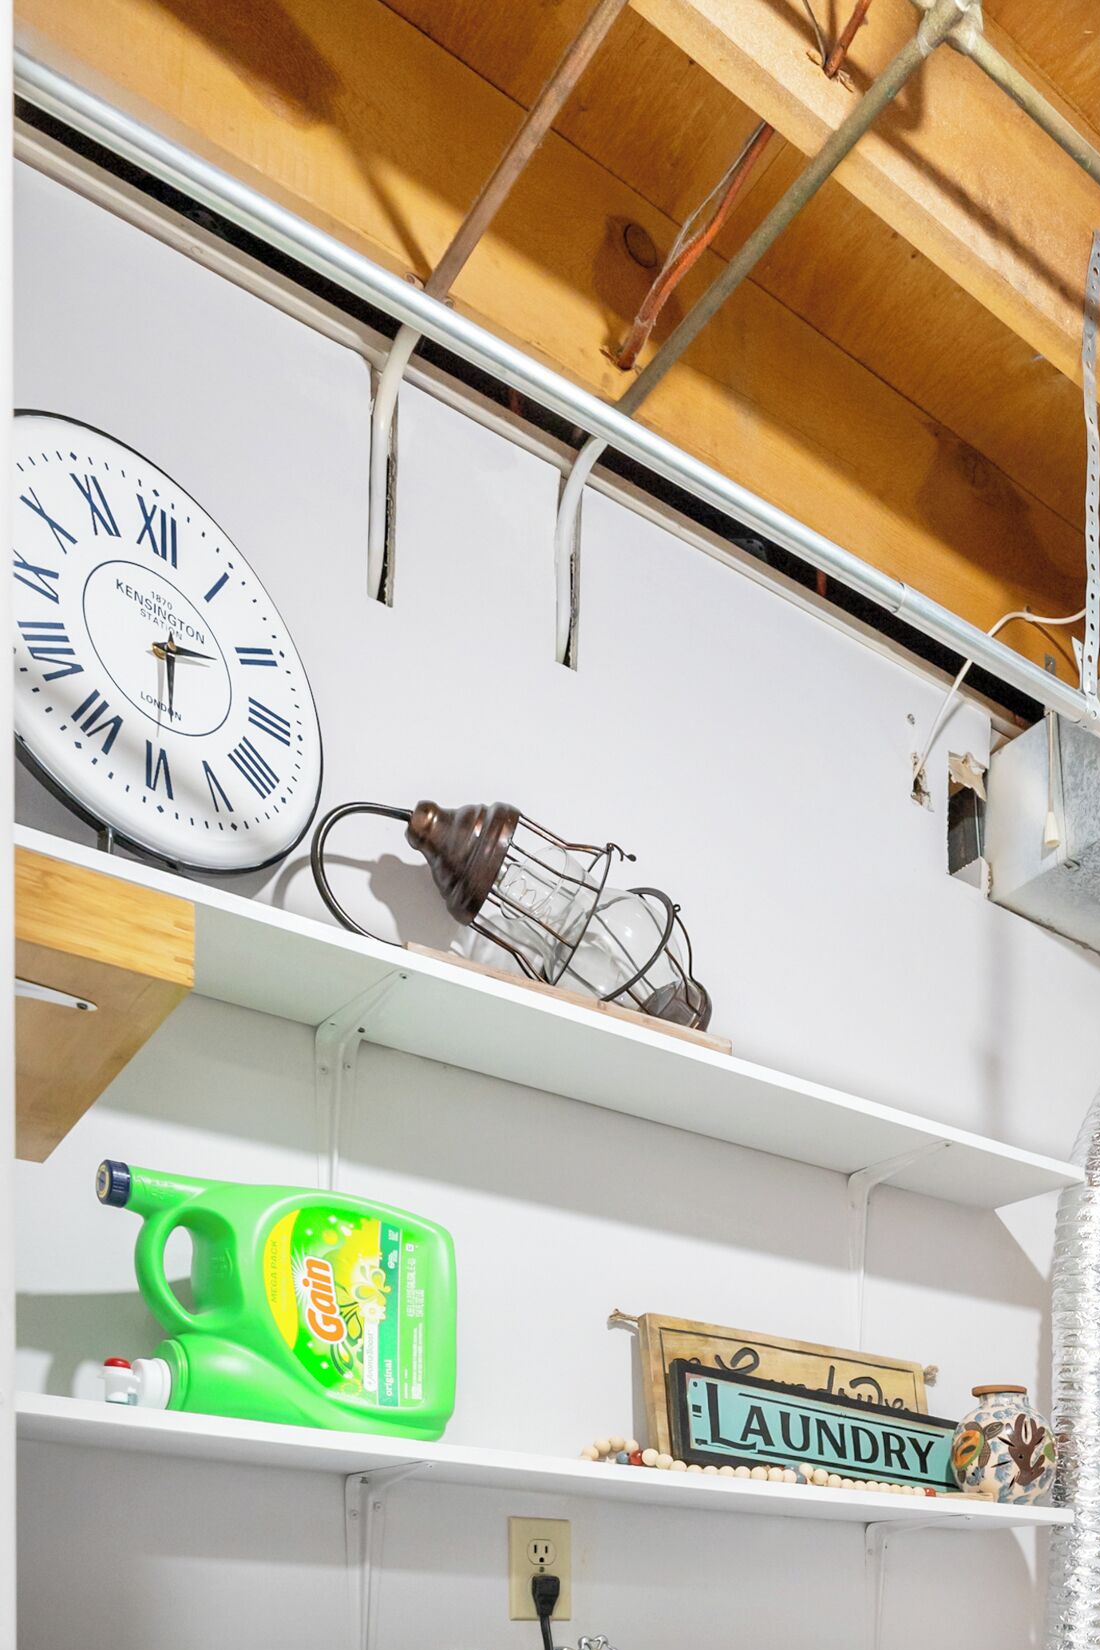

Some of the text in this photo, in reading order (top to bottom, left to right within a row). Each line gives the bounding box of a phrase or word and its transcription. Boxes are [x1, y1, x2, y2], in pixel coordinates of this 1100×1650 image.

[19, 487, 78, 554] X
[136, 493, 178, 569] XII
[116, 579, 205, 645] KENSINGTON
[140, 608, 183, 641] STATION
[150, 591, 173, 610] 1870
[140, 691, 182, 721] LONDON
[302, 1258, 346, 1342] Gain
[385, 1359, 393, 1397] original
[705, 1382, 936, 1475] LAUNDRY
